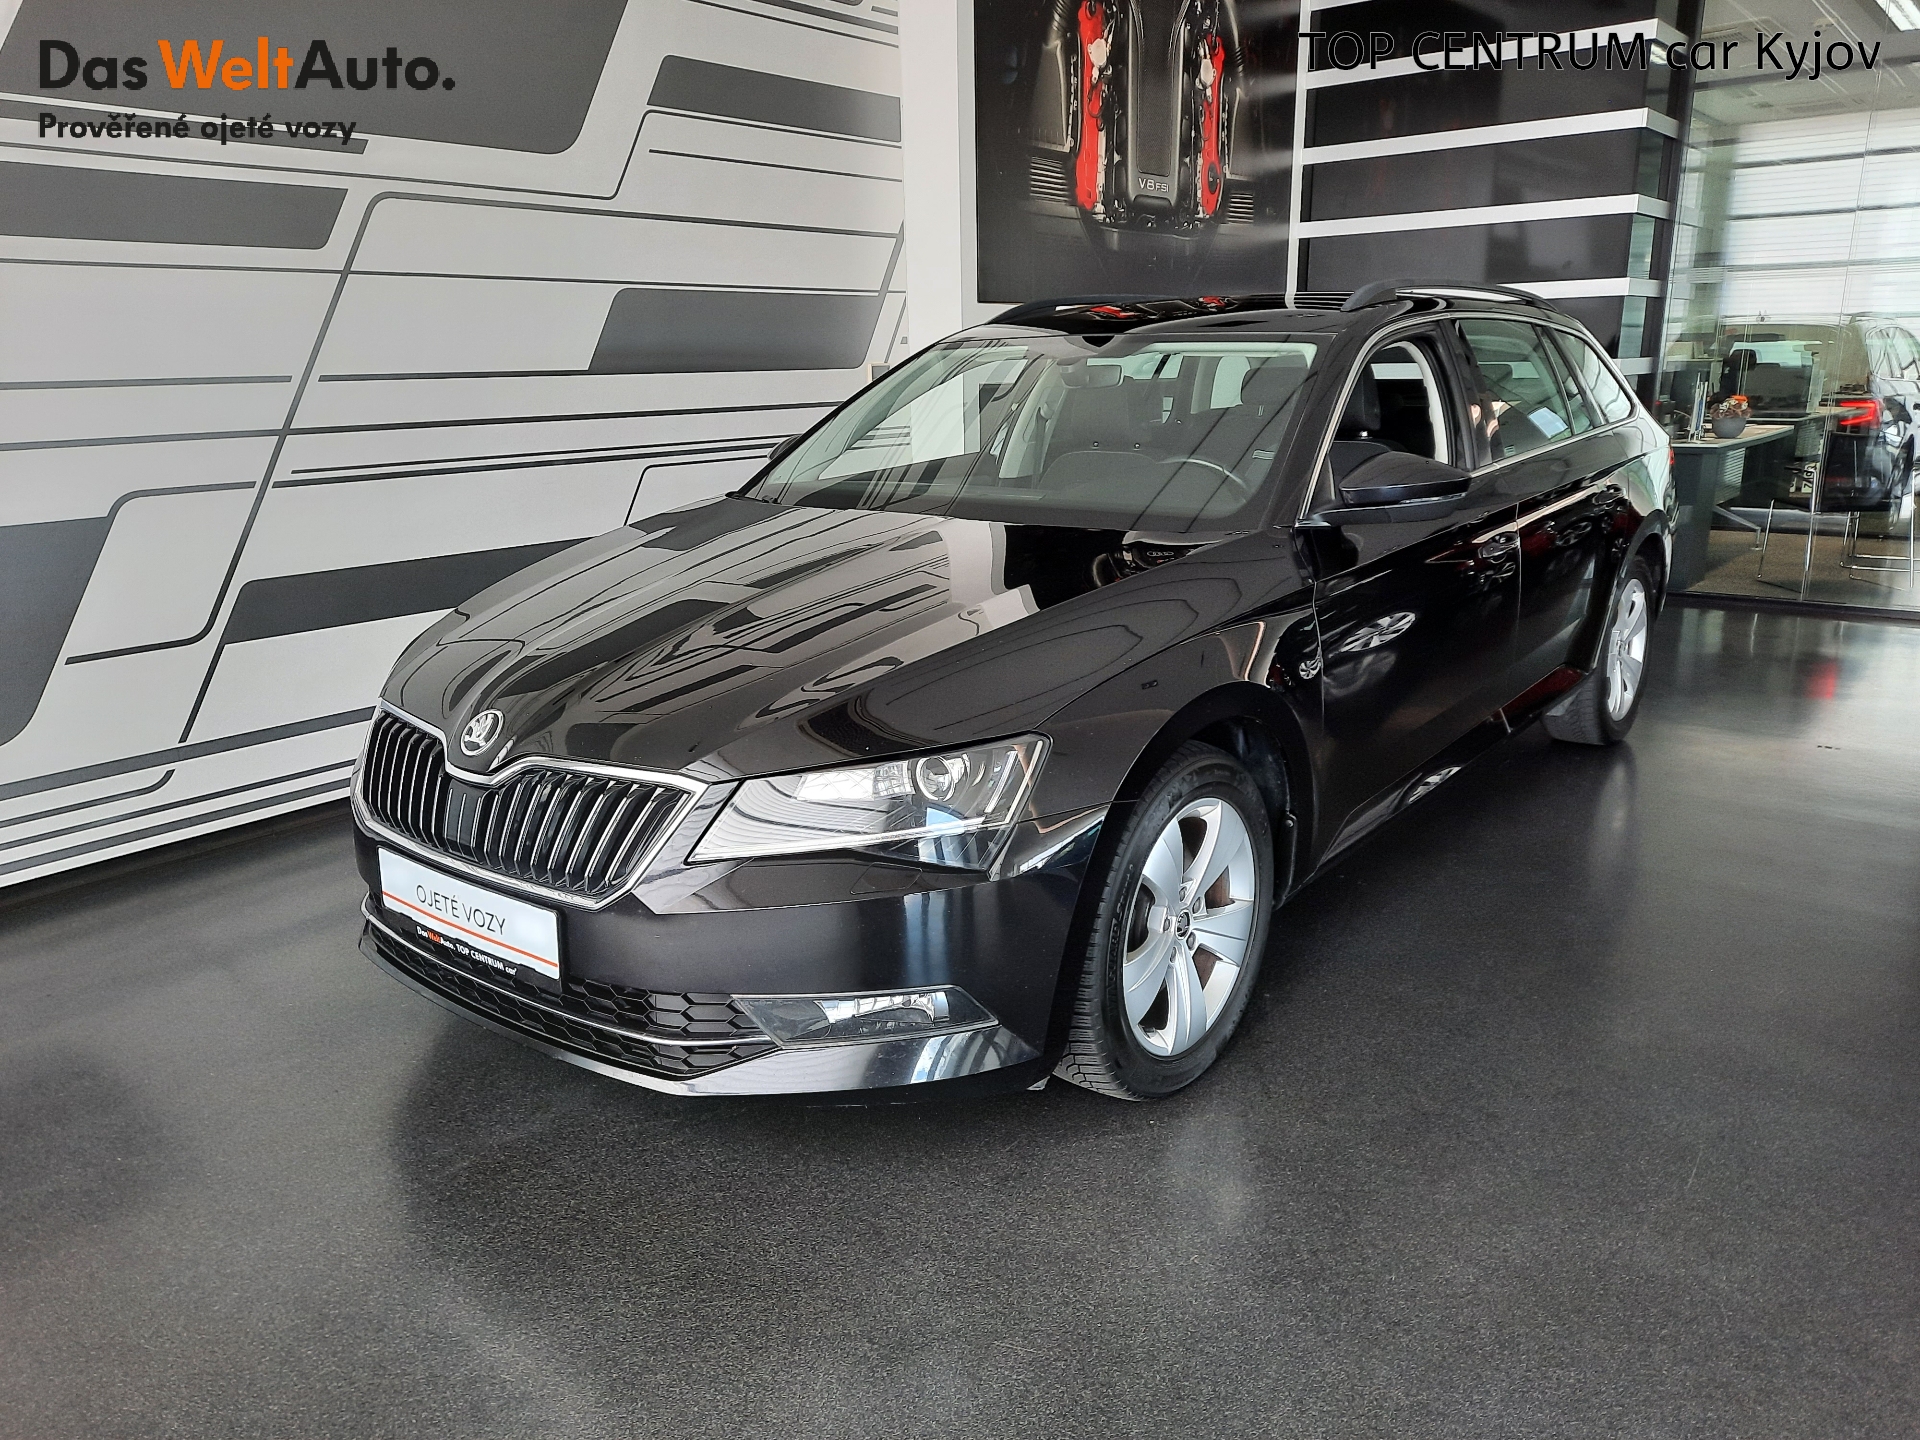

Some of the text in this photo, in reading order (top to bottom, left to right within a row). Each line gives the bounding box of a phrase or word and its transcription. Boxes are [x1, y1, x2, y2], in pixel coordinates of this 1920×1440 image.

[416, 884, 506, 936] OJETÉ VOZY
[456, 943, 470, 956] TOP
[470, 949, 505, 971] CENTRUM
